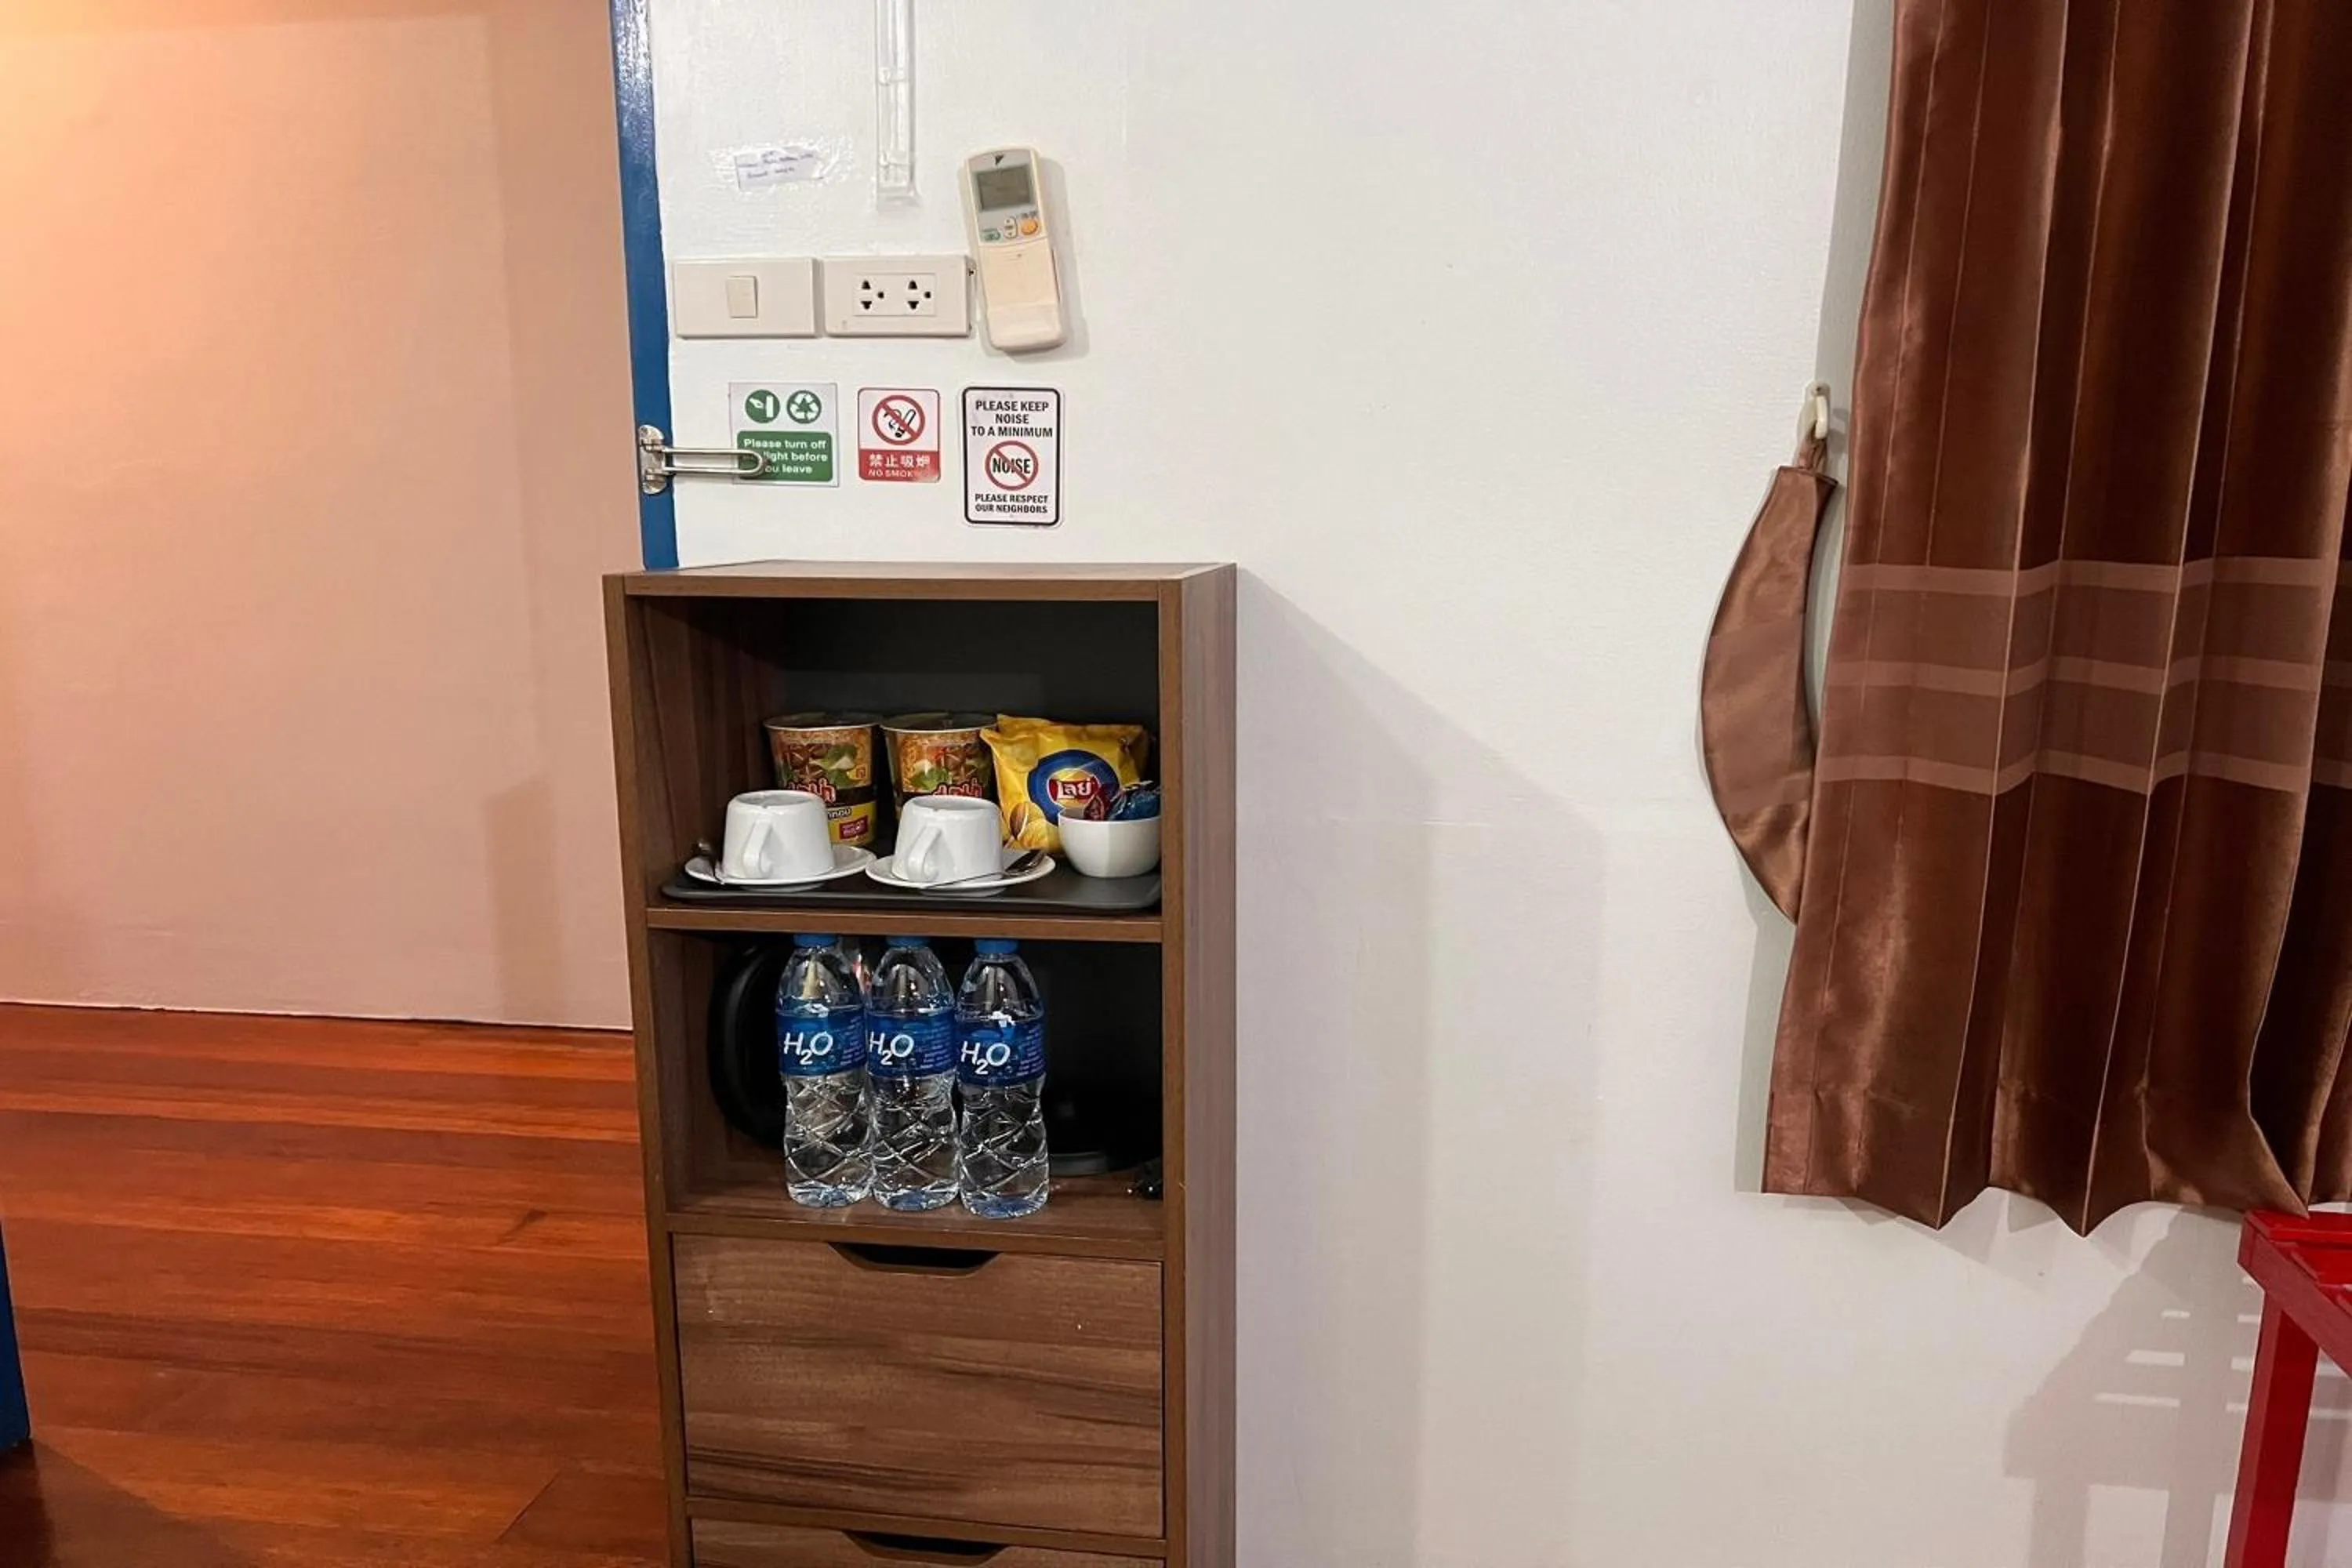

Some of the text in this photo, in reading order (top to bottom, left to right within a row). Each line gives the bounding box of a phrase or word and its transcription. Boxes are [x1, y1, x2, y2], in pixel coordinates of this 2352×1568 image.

[975, 401, 1049, 412] PLEASE KEEP
[995, 413, 1029, 424] NOISE
[971, 426, 1053, 437] TO A MINIMUM
[743, 438, 827, 449] Please turn off
[791, 452, 828, 462] before
[764, 464, 813, 474] ou leave
[992, 458, 1031, 474] NOISE
[885, 469, 916, 477] SMOK
[975, 494, 1048, 503] PLEASE RESPECT
[996, 505, 1048, 514] NEIGHBORS
[783, 1031, 833, 1065] H2O
[869, 1031, 915, 1065] H2O
[960, 1040, 1011, 1075] H2O
